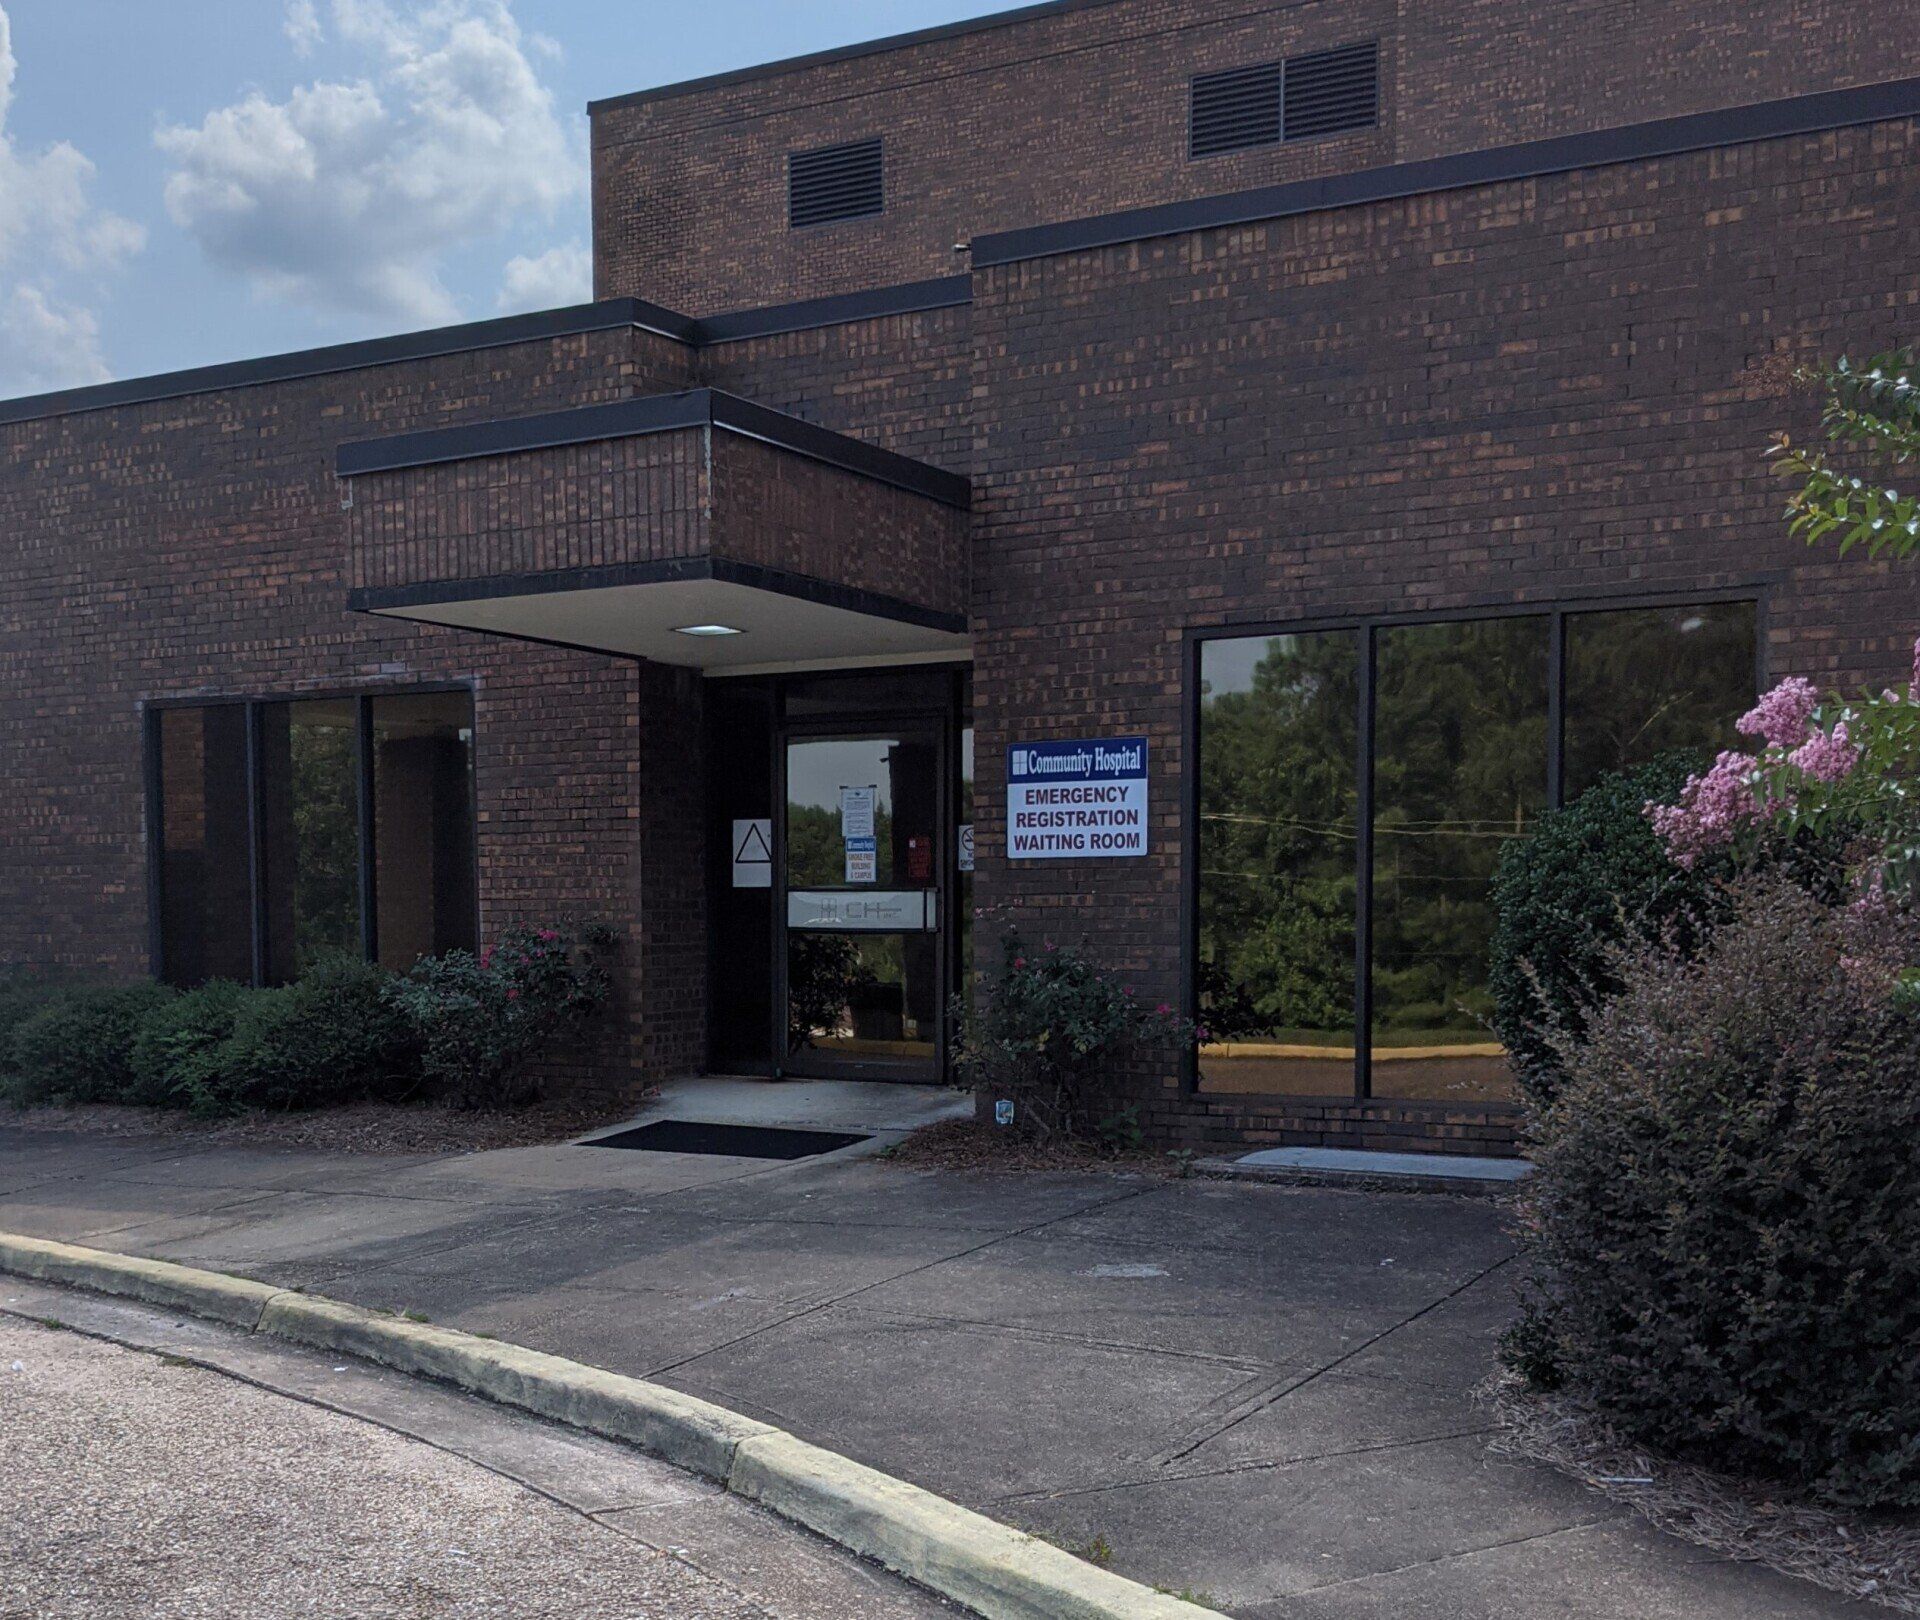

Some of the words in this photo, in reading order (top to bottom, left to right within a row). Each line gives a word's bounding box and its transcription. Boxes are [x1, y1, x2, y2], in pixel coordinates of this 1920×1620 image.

[1029, 748, 1093, 777] Community
[1095, 745, 1141, 776] Hospital
[1025, 786, 1129, 805] EMERGENCY
[1016, 809, 1138, 828] REGISTRATION
[1014, 834, 1085, 851] WAITING
[1090, 832, 1140, 849] ROOM
